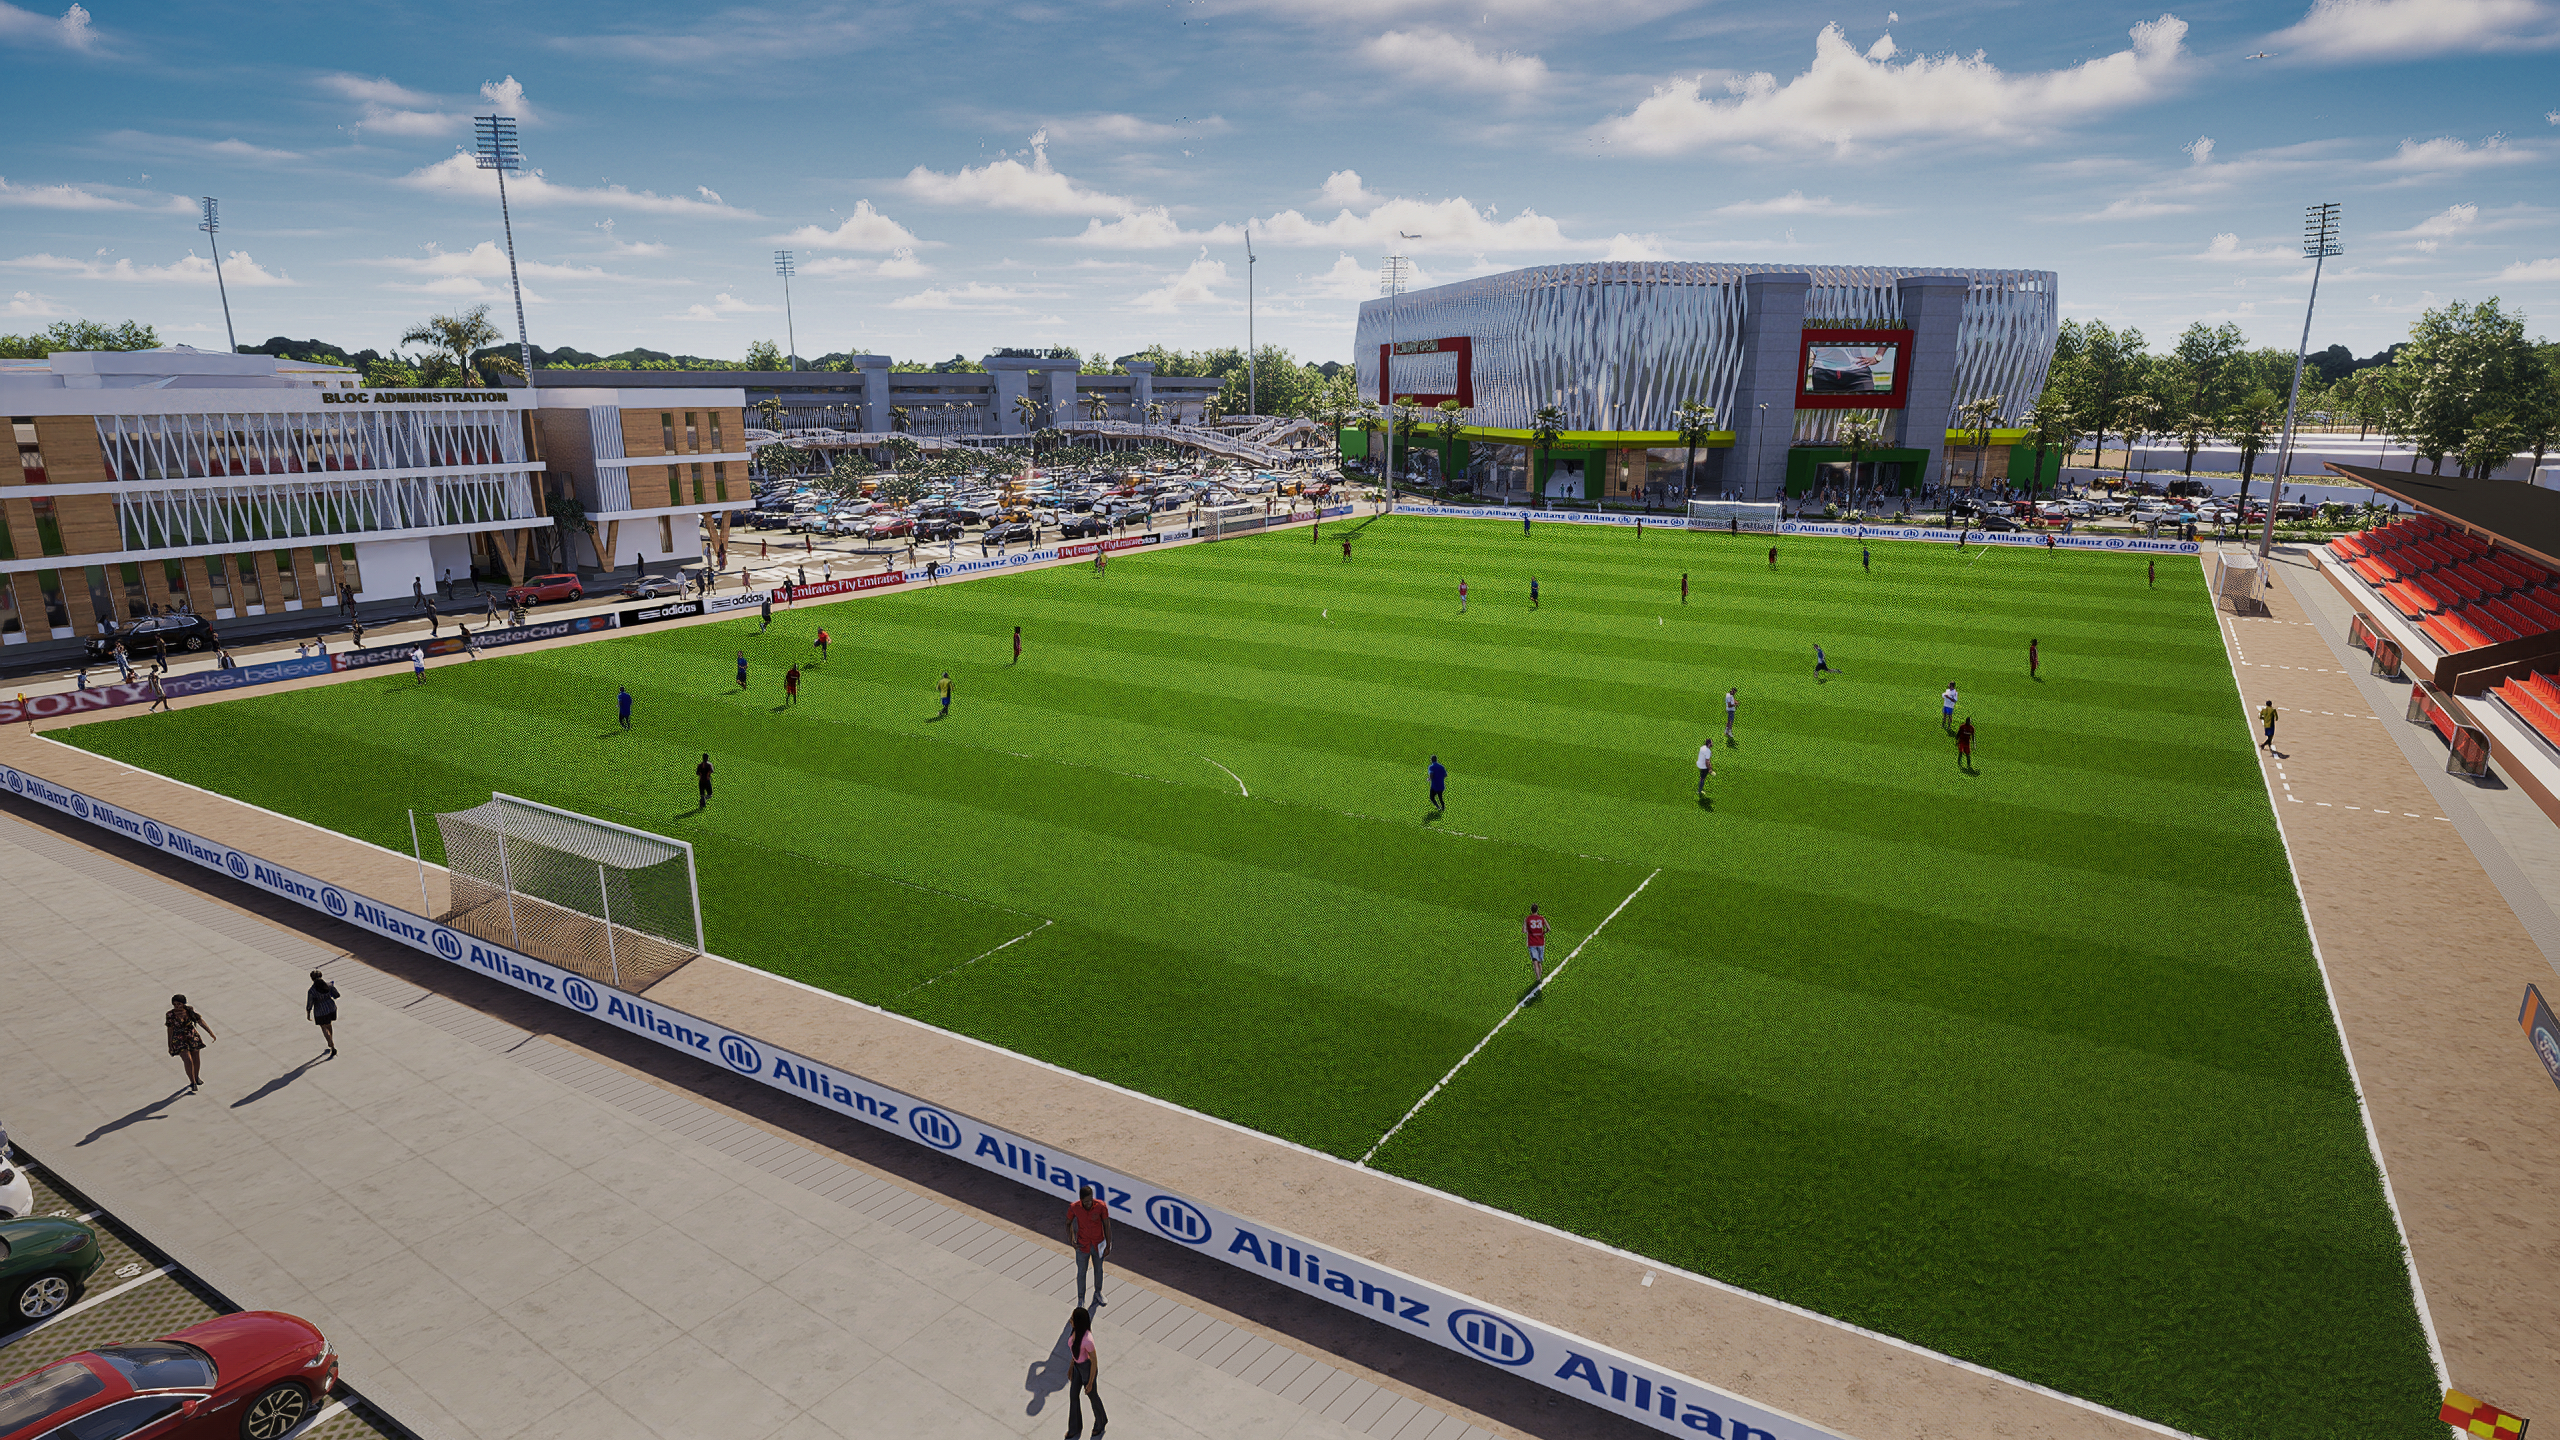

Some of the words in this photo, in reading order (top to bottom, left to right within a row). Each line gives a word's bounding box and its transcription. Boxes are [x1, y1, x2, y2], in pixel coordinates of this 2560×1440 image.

[322, 392, 369, 404] BLOC
[373, 392, 509, 404] ADMINISTRATION
[1395, 505, 1425, 513] Allianz
[1440, 507, 1470, 515] Allianz
[1485, 509, 1517, 517] Allianz
[1533, 512, 1566, 520] Allianz
[1583, 514, 1616, 522] Allianz
[1799, 524, 1838, 533] Allianz
[1987, 533, 2033, 544] Allianz
[2056, 536, 2103, 547] Allianz
[2127, 539, 2176, 551] Allianz
[957, 559, 1007, 572] Allianz
[791, 583, 837, 598] Emirates
[839, 580, 856, 592] Fly
[857, 574, 900, 588] Emirates
[732, 592, 764, 606] adidas
[661, 603, 697, 617] adidas
[472, 622, 569, 646] MasterCard
[0, 681, 150, 722] SONY
[1529, 919, 1543, 929] 33
[26, 779, 70, 808] Allianz
[92, 804, 140, 836] Allianz
[168, 832, 223, 867] Allianz
[253, 863, 319, 904] Allianz
[353, 900, 429, 945] Allianz
[469, 944, 558, 996] Allianz
[607, 994, 712, 1055] Allianz
[772, 1056, 900, 1126] Allianz
[974, 1132, 1133, 1214] Allianz
[1227, 1227, 1431, 1329] Allianz
